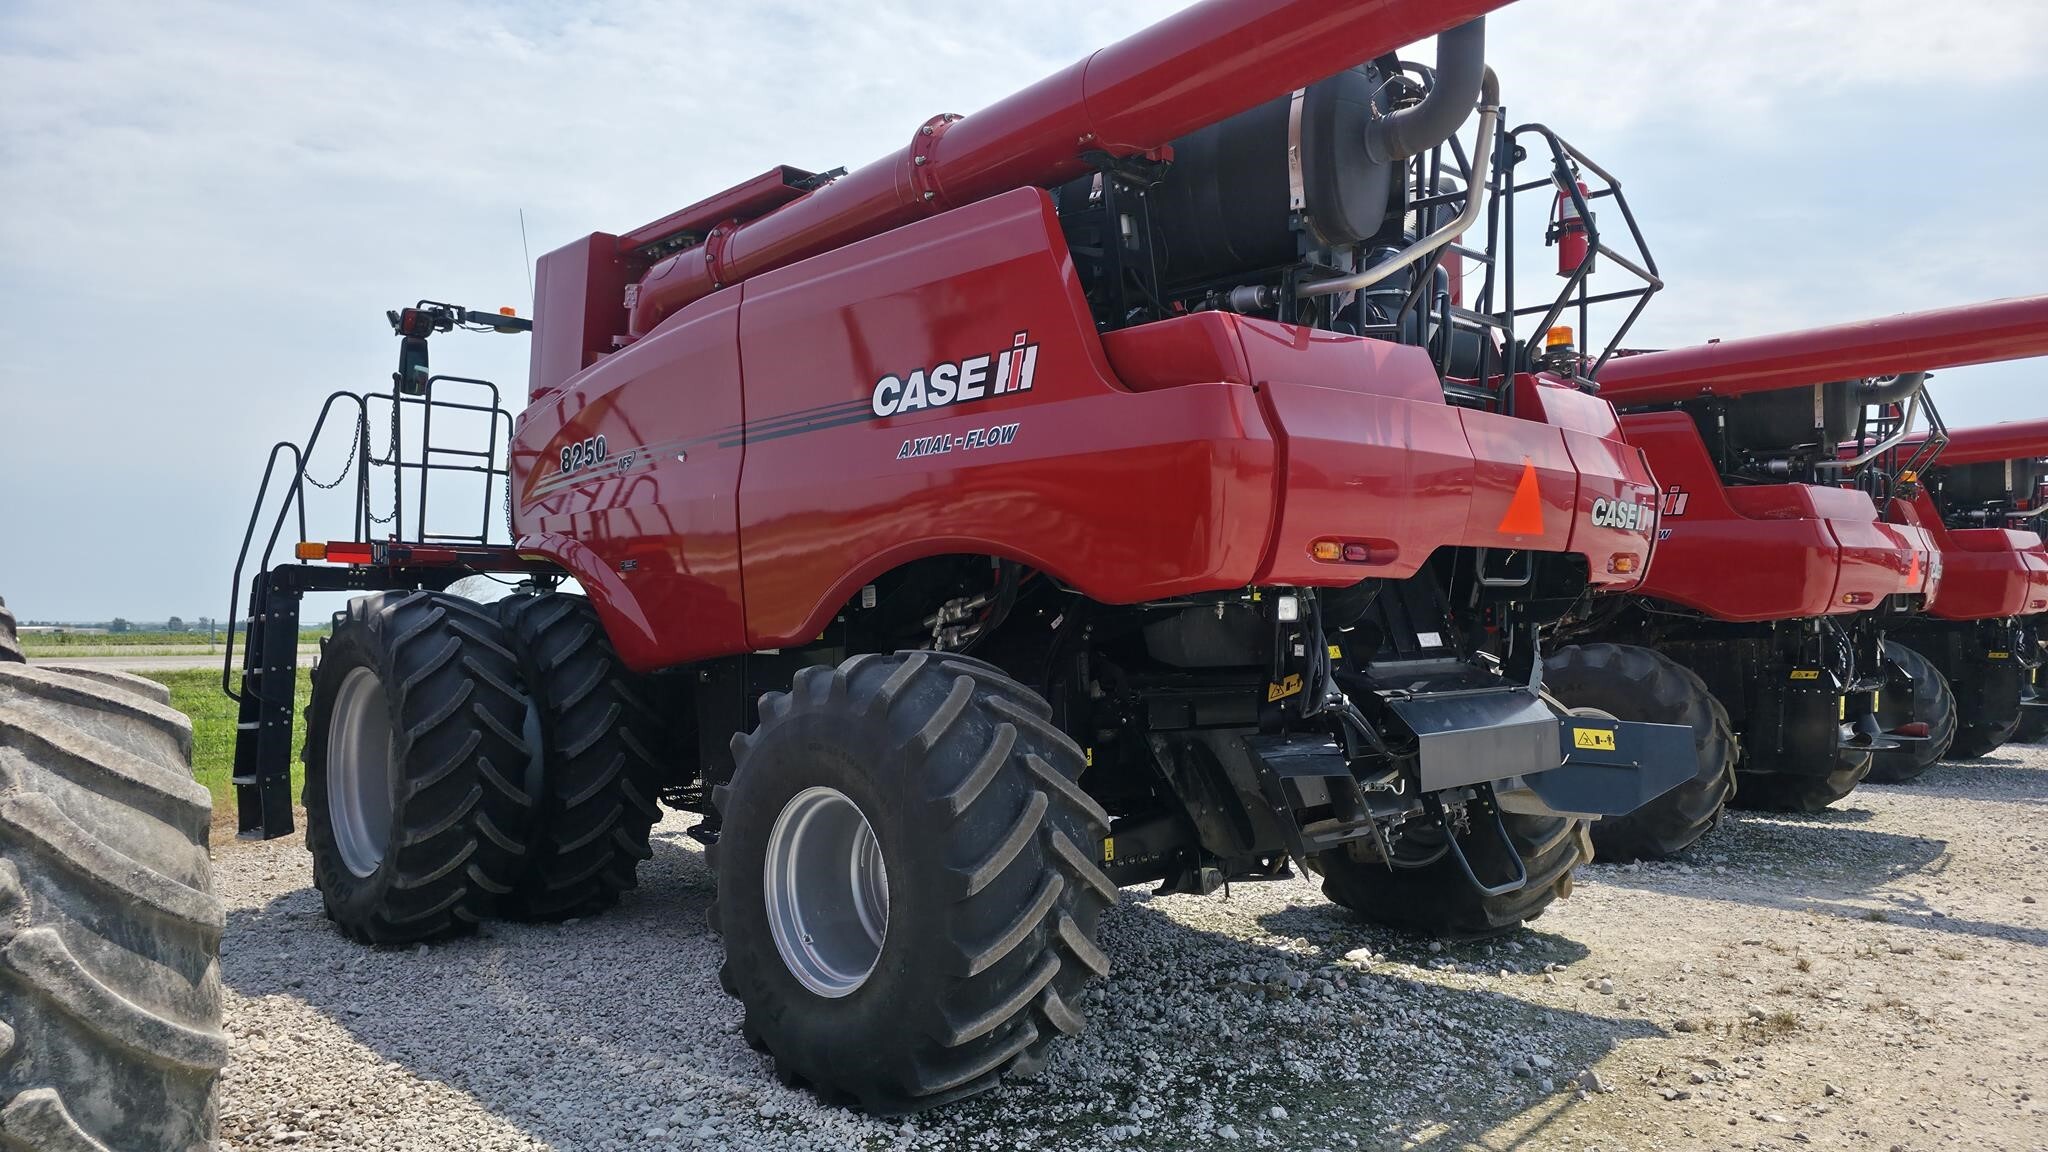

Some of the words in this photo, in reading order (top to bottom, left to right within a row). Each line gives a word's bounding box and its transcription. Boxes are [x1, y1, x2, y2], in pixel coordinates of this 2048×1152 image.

[871, 355, 991, 417] CASE
[561, 434, 607, 474] 8250
[896, 422, 1020, 460] AXIAL-FLOW
[1591, 497, 1637, 530] CASE
